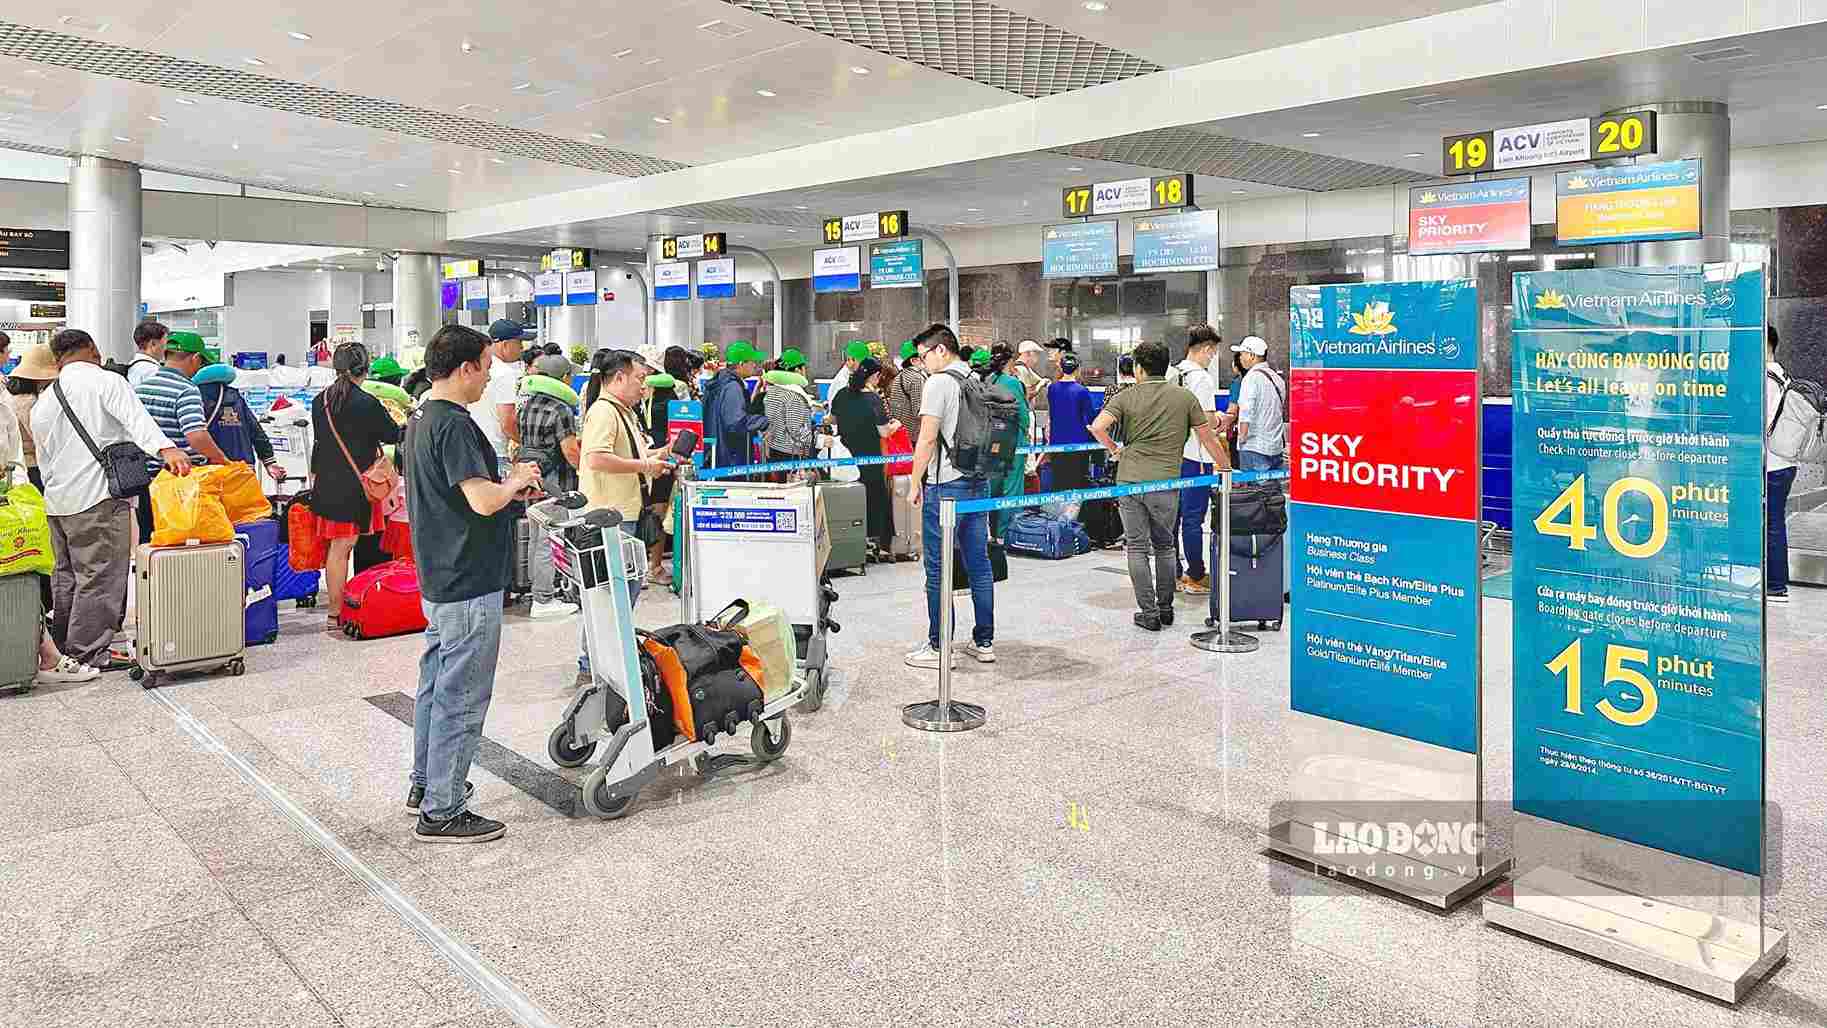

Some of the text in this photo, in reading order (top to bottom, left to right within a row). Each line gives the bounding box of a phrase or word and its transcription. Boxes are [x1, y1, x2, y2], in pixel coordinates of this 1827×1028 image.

[1499, 133, 1541, 152] ACV
[1597, 117, 1643, 153] 20
[1449, 138, 1487, 170] 19
[1065, 190, 1090, 213] 17
[1097, 188, 1121, 201] ACV
[1155, 179, 1182, 204] 18
[825, 222, 841, 241] 15
[844, 220, 861, 231] ACV
[880, 214, 899, 234] 16
[1418, 215, 1447, 226] SKY
[1418, 223, 1488, 238] PRIORITY
[664, 240, 676, 257] 13
[678, 240, 689, 248] ACV
[704, 236, 718, 252] 14
[572, 251, 585, 267] 12
[1535, 349, 1730, 371] HÃY CÙNG BAY ĐÚNG GIỜ
[1578, 377, 1597, 394] all
[1604, 378, 1649, 395] leave
[1656, 383, 1676, 396] on
[1683, 380, 1727, 397] time
[1300, 432, 1364, 458] SKY
[1701, 434, 1730, 447] hành
[1539, 443, 1576, 456] Check-in
[1578, 446, 1611, 457] counter
[1678, 450, 1729, 465] departure
[1300, 457, 1456, 492] PRIORITY
[1671, 481, 1729, 504] phút
[1533, 473, 1669, 559] 40
[1672, 507, 1729, 521] minutes
[1307, 546, 1377, 564] Business Class
[1371, 543, 1388, 553] gia
[1306, 564, 1323, 576] Hội
[1324, 568, 1345, 579] viên
[1364, 573, 1390, 585] Bạch
[1392, 576, 1438, 593] Kim/Elite
[1440, 584, 1465, 597] Plus
[1306, 577, 1433, 606] Platinum/Elite Plus Member
[1555, 590, 1565, 600] ra
[1567, 590, 1587, 604] máy
[1588, 592, 1606, 606] bay
[1607, 595, 1632, 611] đóng
[1703, 608, 1732, 624] hành
[1538, 601, 1728, 641] Boarding gate closes before departure
[1306, 632, 1324, 646] Hội
[1325, 636, 1345, 649] viên
[1365, 644, 1448, 669] Vàng/Titan/Elite
[1306, 646, 1433, 680] Gold/Titanium/Elite Member
[1656, 655, 1714, 680] phút
[1544, 637, 1659, 727] 15
[1657, 678, 1714, 697] minutes
